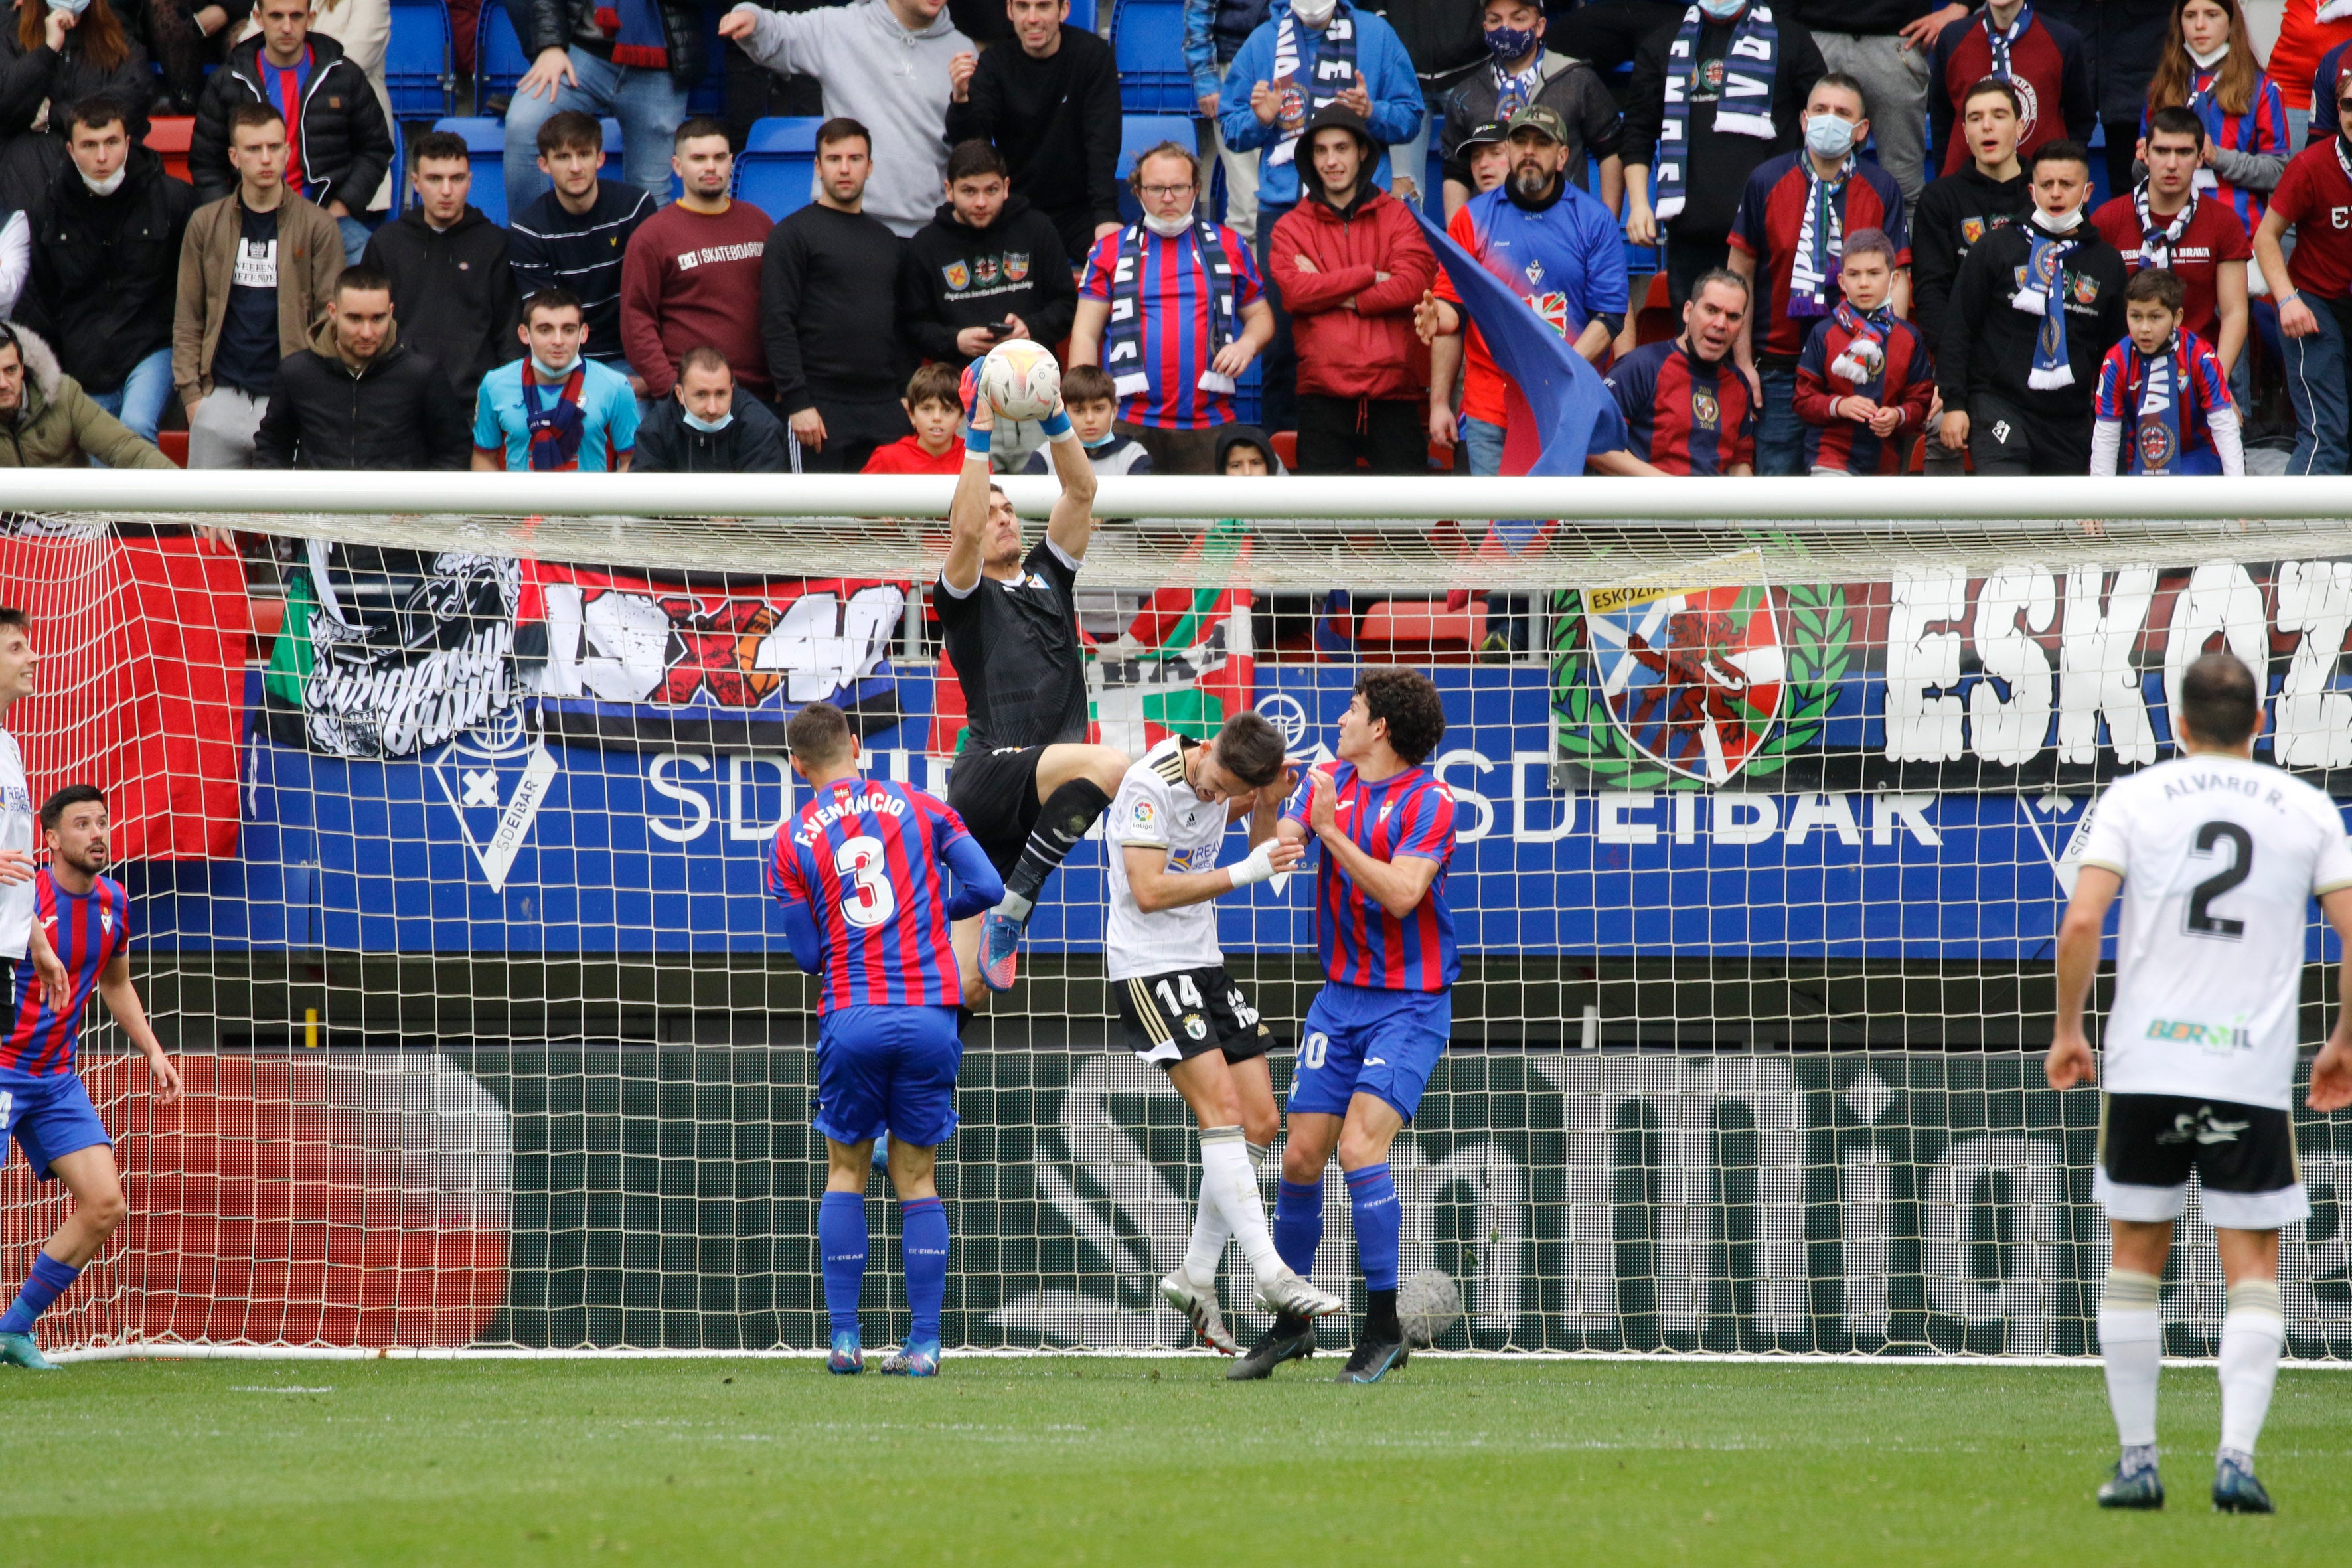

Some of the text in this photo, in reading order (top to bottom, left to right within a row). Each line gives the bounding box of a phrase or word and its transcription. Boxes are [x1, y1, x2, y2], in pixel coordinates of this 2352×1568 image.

[2179, 247, 2211, 258] BRAVA
[794, 793, 905, 848] F.VENANCIO
[834, 835, 895, 928] 3
[2181, 819, 2253, 943] 2
[1154, 975, 1204, 1018] 14
